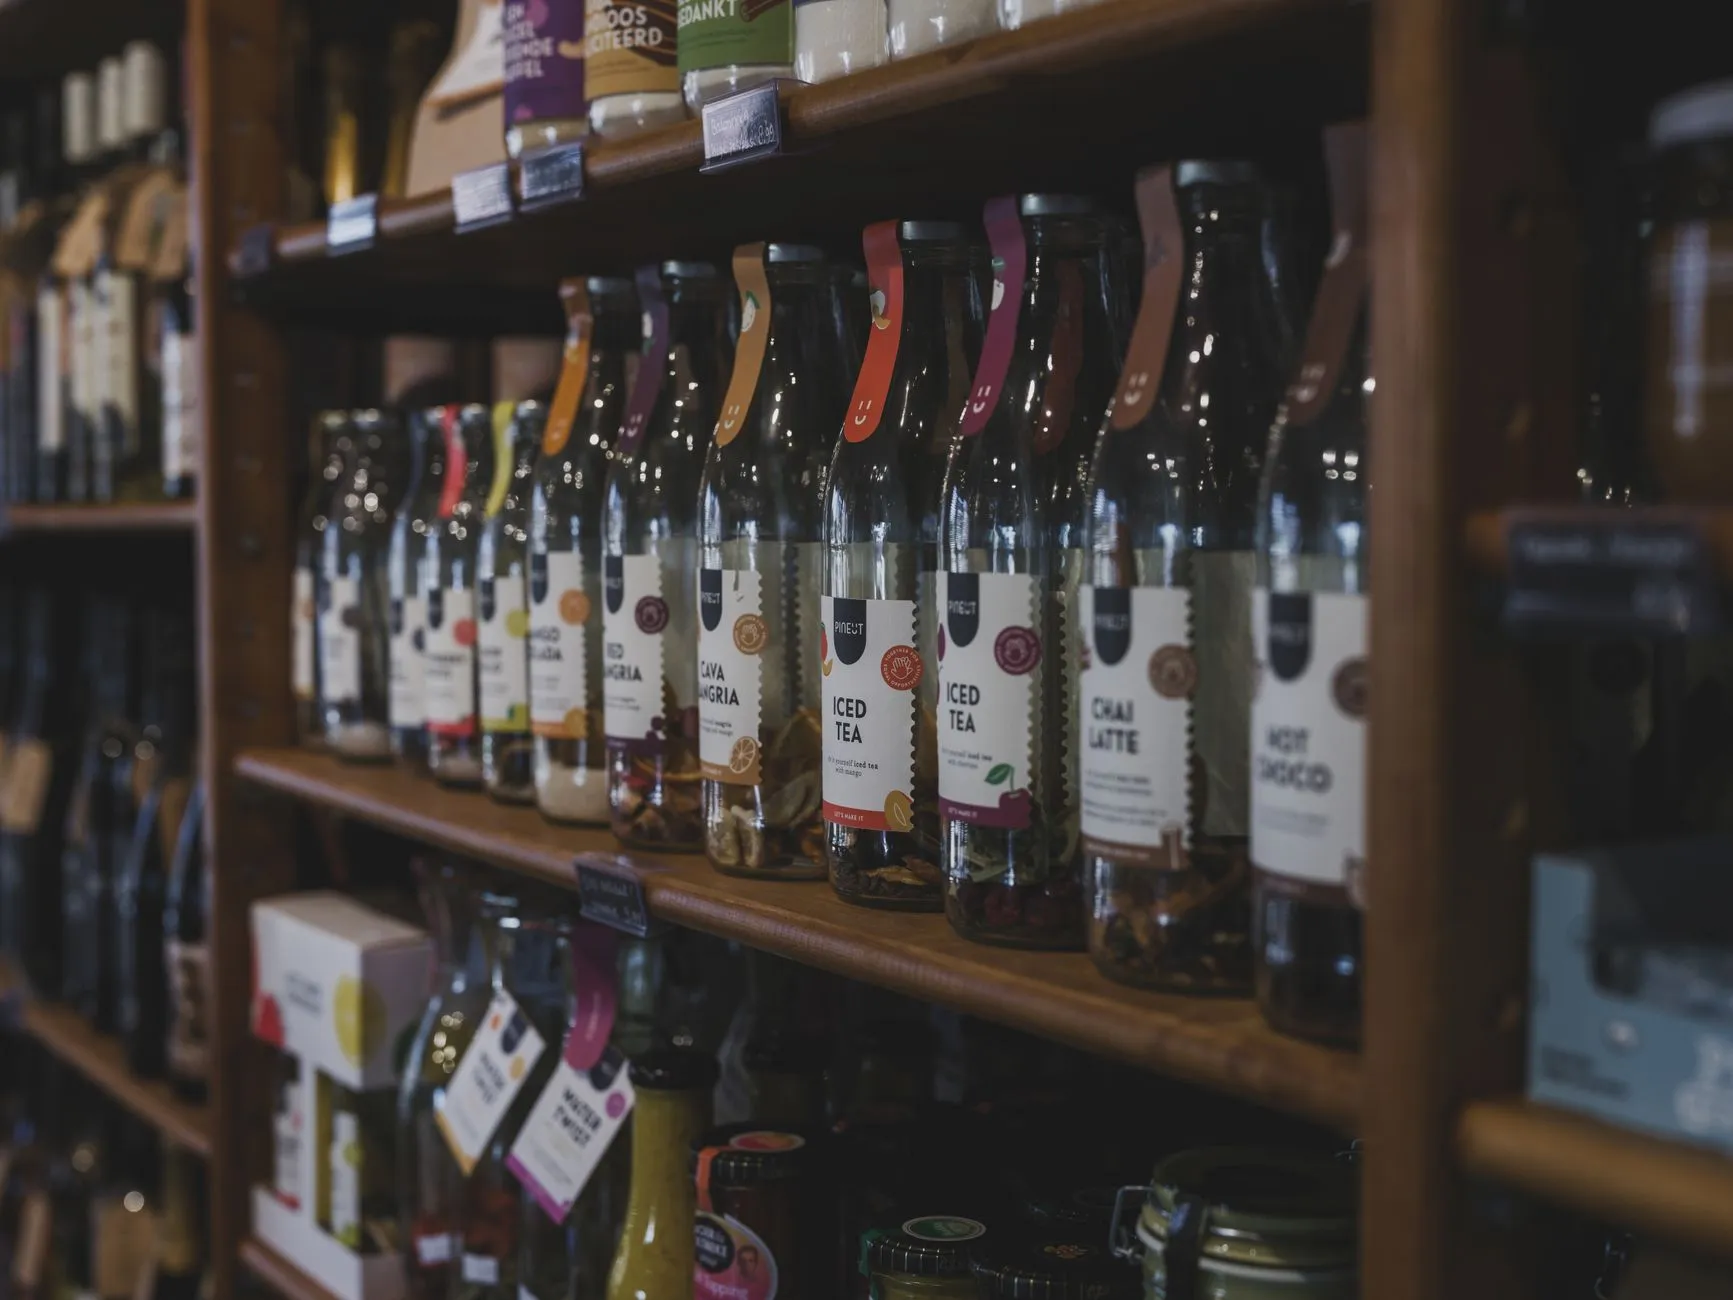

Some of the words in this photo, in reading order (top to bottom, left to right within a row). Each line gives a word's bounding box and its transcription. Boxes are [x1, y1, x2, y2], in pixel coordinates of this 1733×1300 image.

[946, 682, 981, 706] ICED
[833, 696, 867, 719] ICED
[836, 721, 862, 743] TEA
[949, 709, 976, 733] TEA
[845, 768, 862, 778] mango
[853, 759, 867, 769] iced
[868, 761, 879, 770] tea
